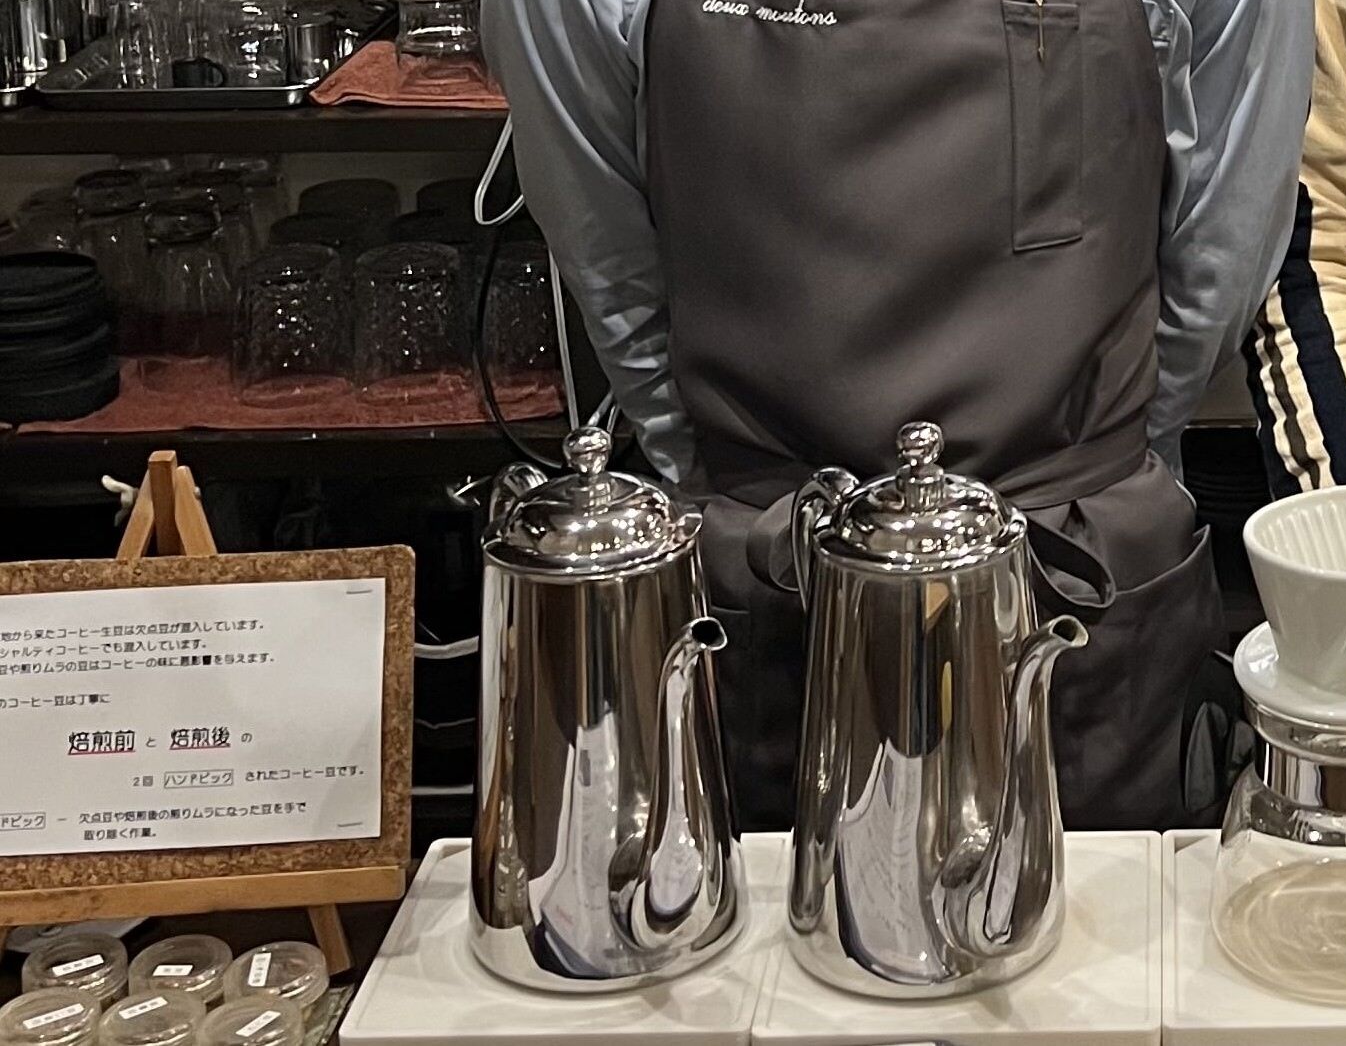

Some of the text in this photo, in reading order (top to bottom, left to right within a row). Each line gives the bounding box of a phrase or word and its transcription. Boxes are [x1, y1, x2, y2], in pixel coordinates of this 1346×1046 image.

[68, 726, 252, 754] 焙煎前 と 焙煎後 の
